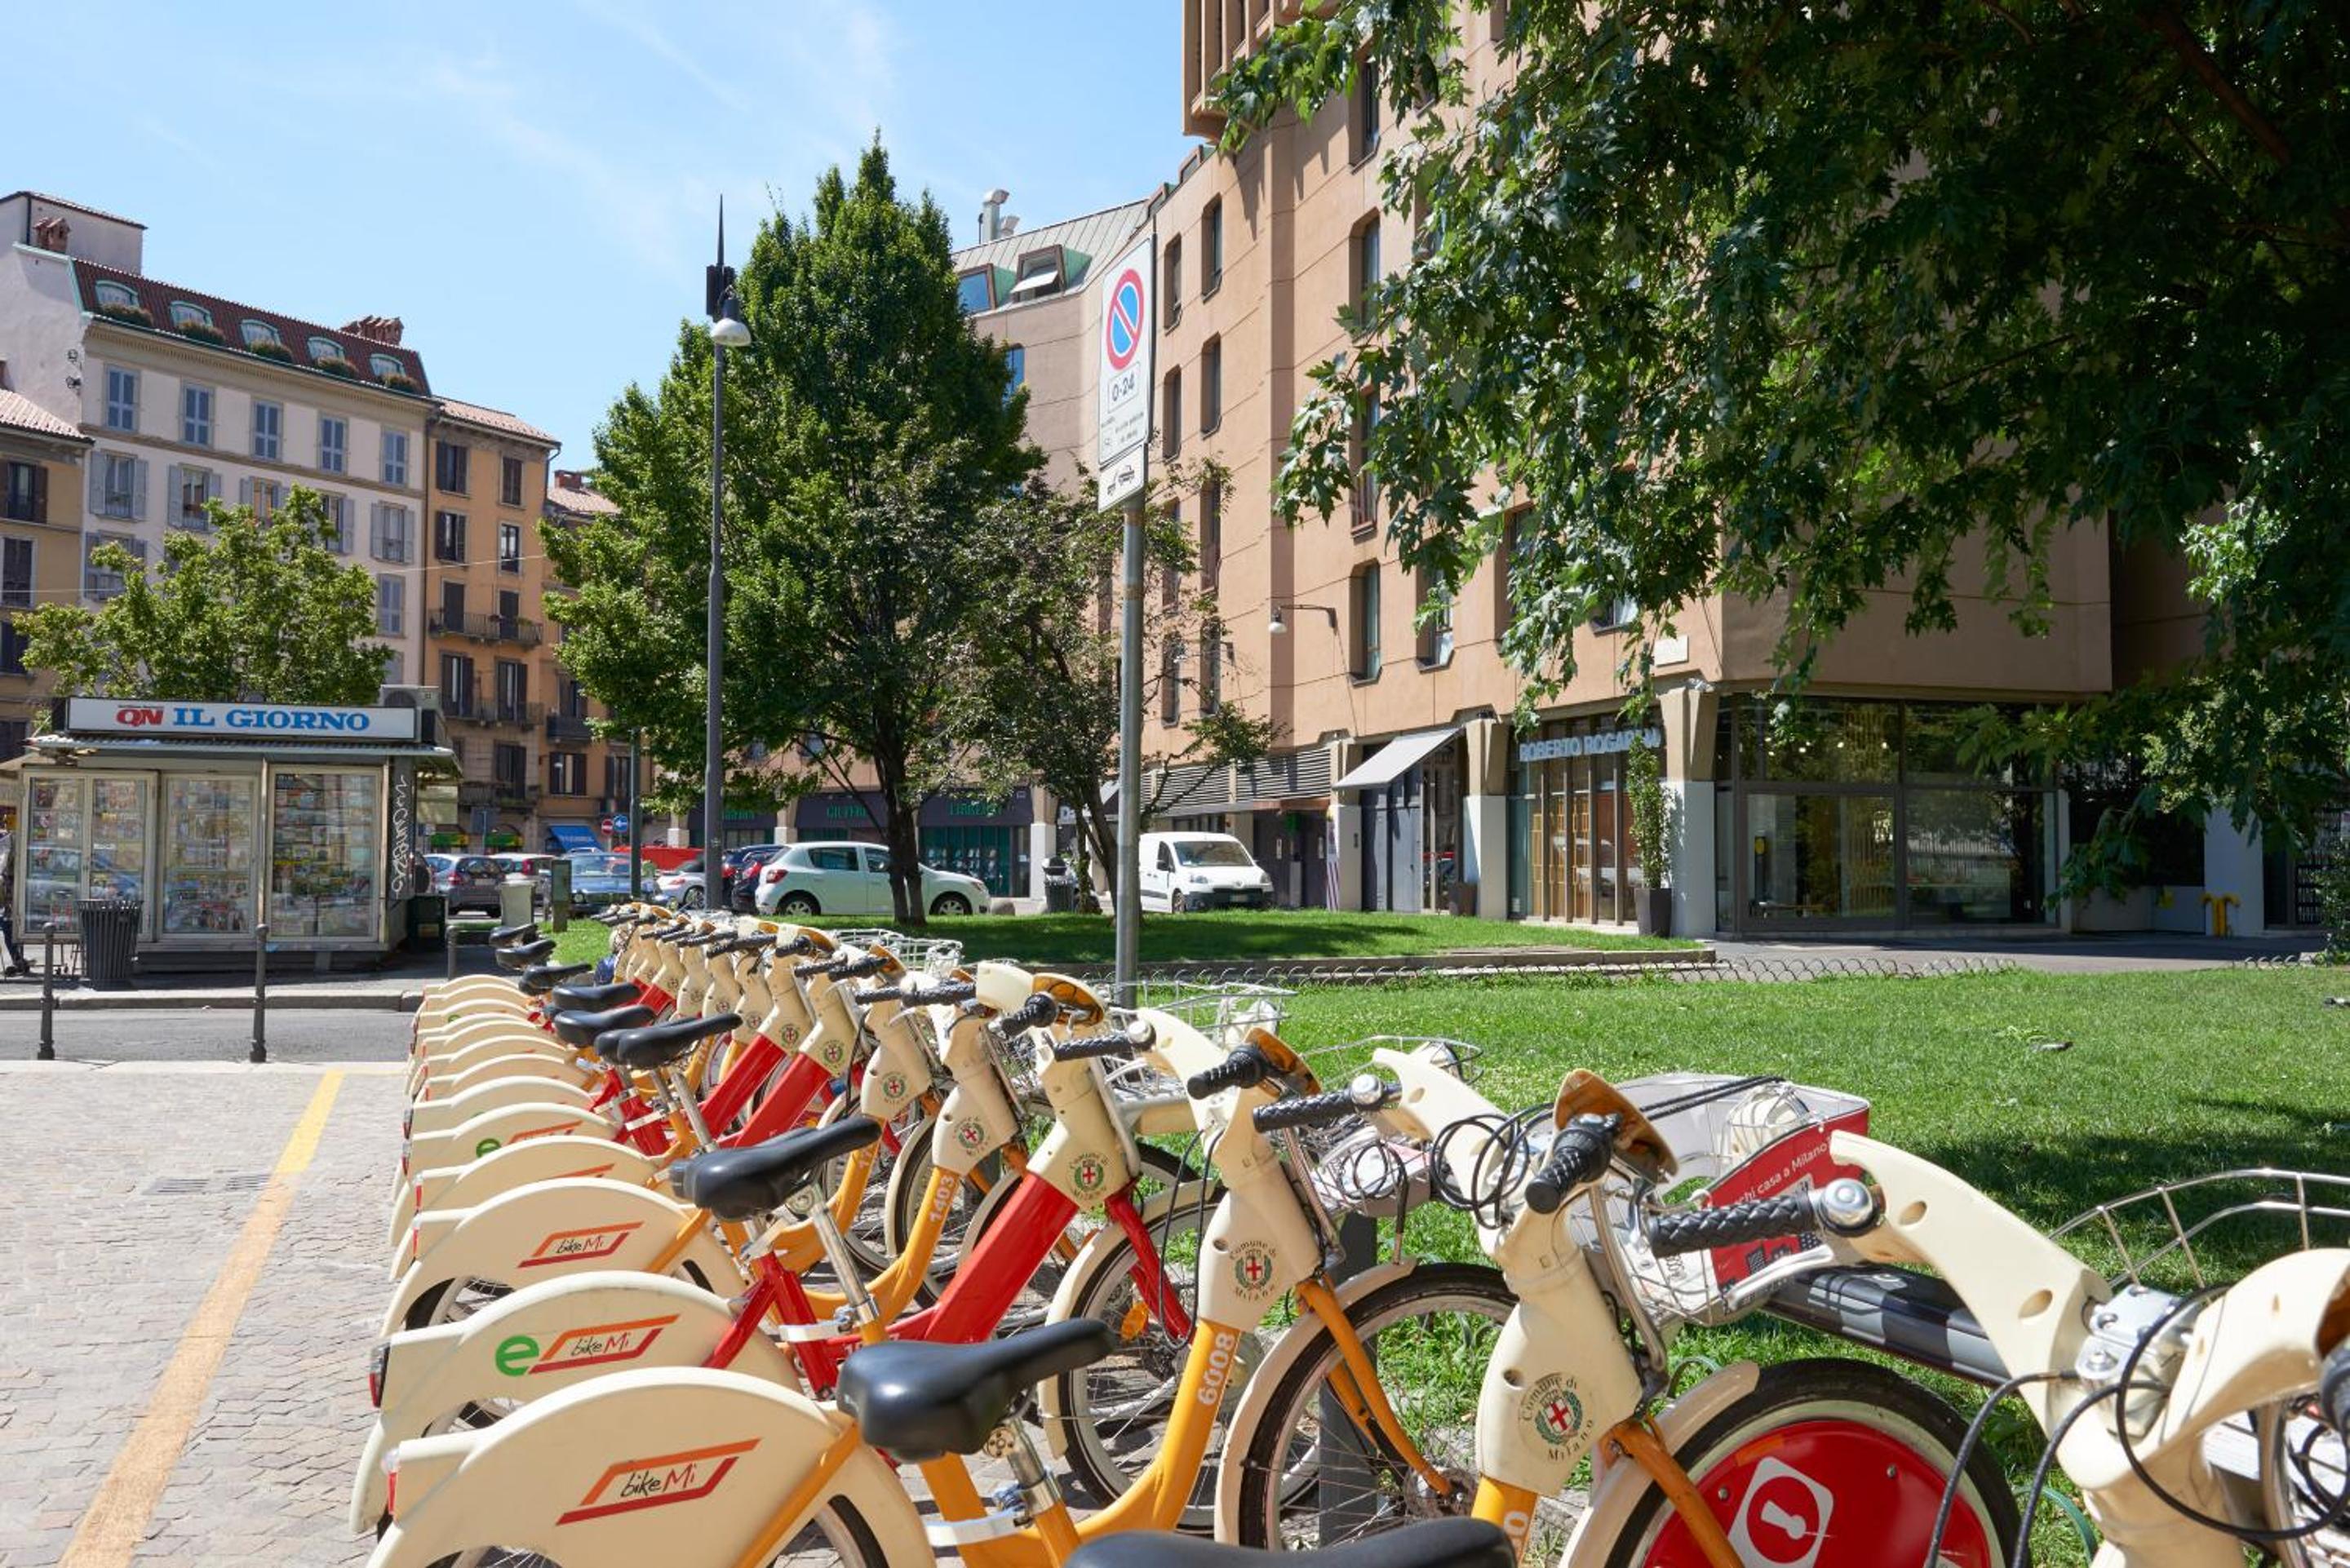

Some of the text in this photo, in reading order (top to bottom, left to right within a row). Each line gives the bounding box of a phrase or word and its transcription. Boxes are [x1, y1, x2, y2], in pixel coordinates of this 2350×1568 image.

[117, 707, 370, 731] QN IL GIORNO
[1757, 1172, 1781, 1194] casa
[1784, 1167, 1790, 1178] a
[1791, 1143, 1828, 1172] Milano
[495, 1334, 539, 1376] e
[1197, 1331, 1235, 1406] 6008
[620, 1463, 697, 1498] bikeMi
